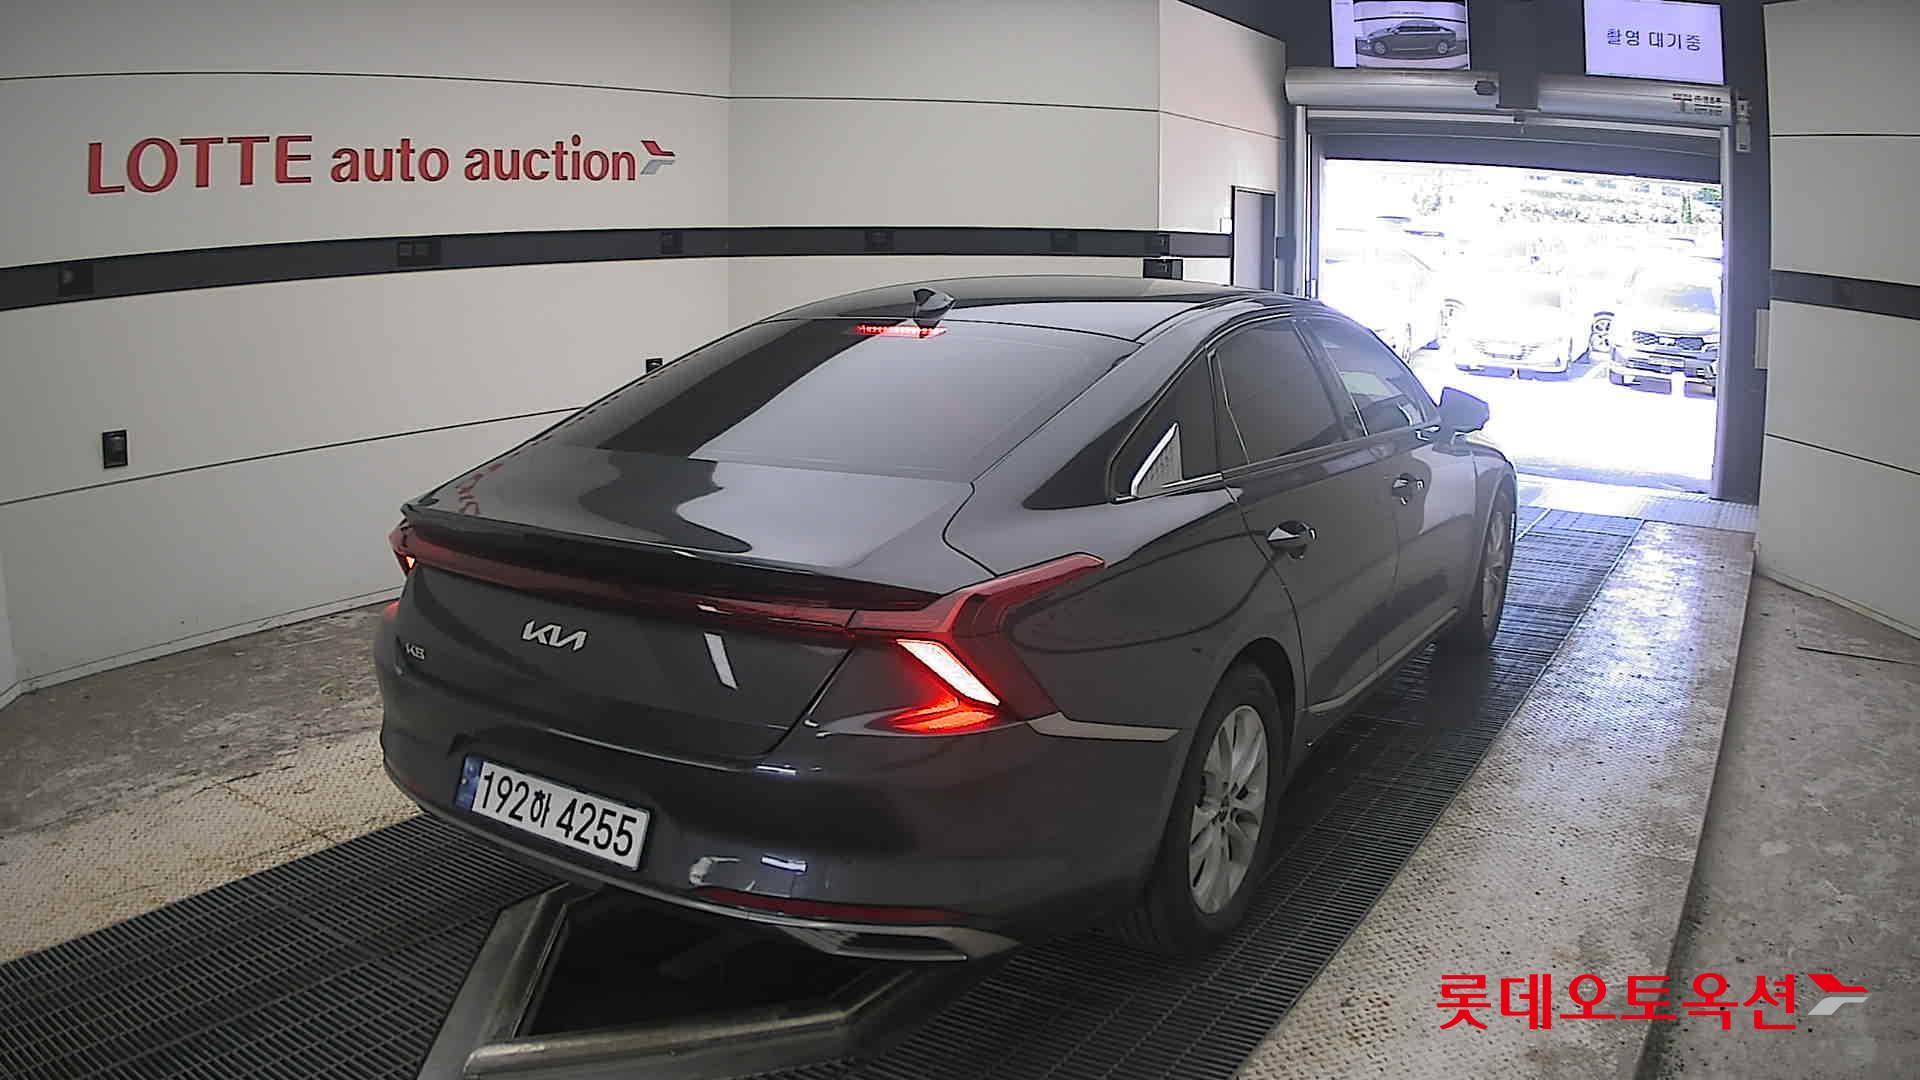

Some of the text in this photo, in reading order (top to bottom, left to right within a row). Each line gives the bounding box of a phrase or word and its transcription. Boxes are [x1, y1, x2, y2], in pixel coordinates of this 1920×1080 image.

[1648, 31, 1701, 52] 대기중
[88, 134, 636, 194] LOTTE auto auction
[522, 619, 588, 651] KIA
[482, 770, 638, 857] 192하 4255
